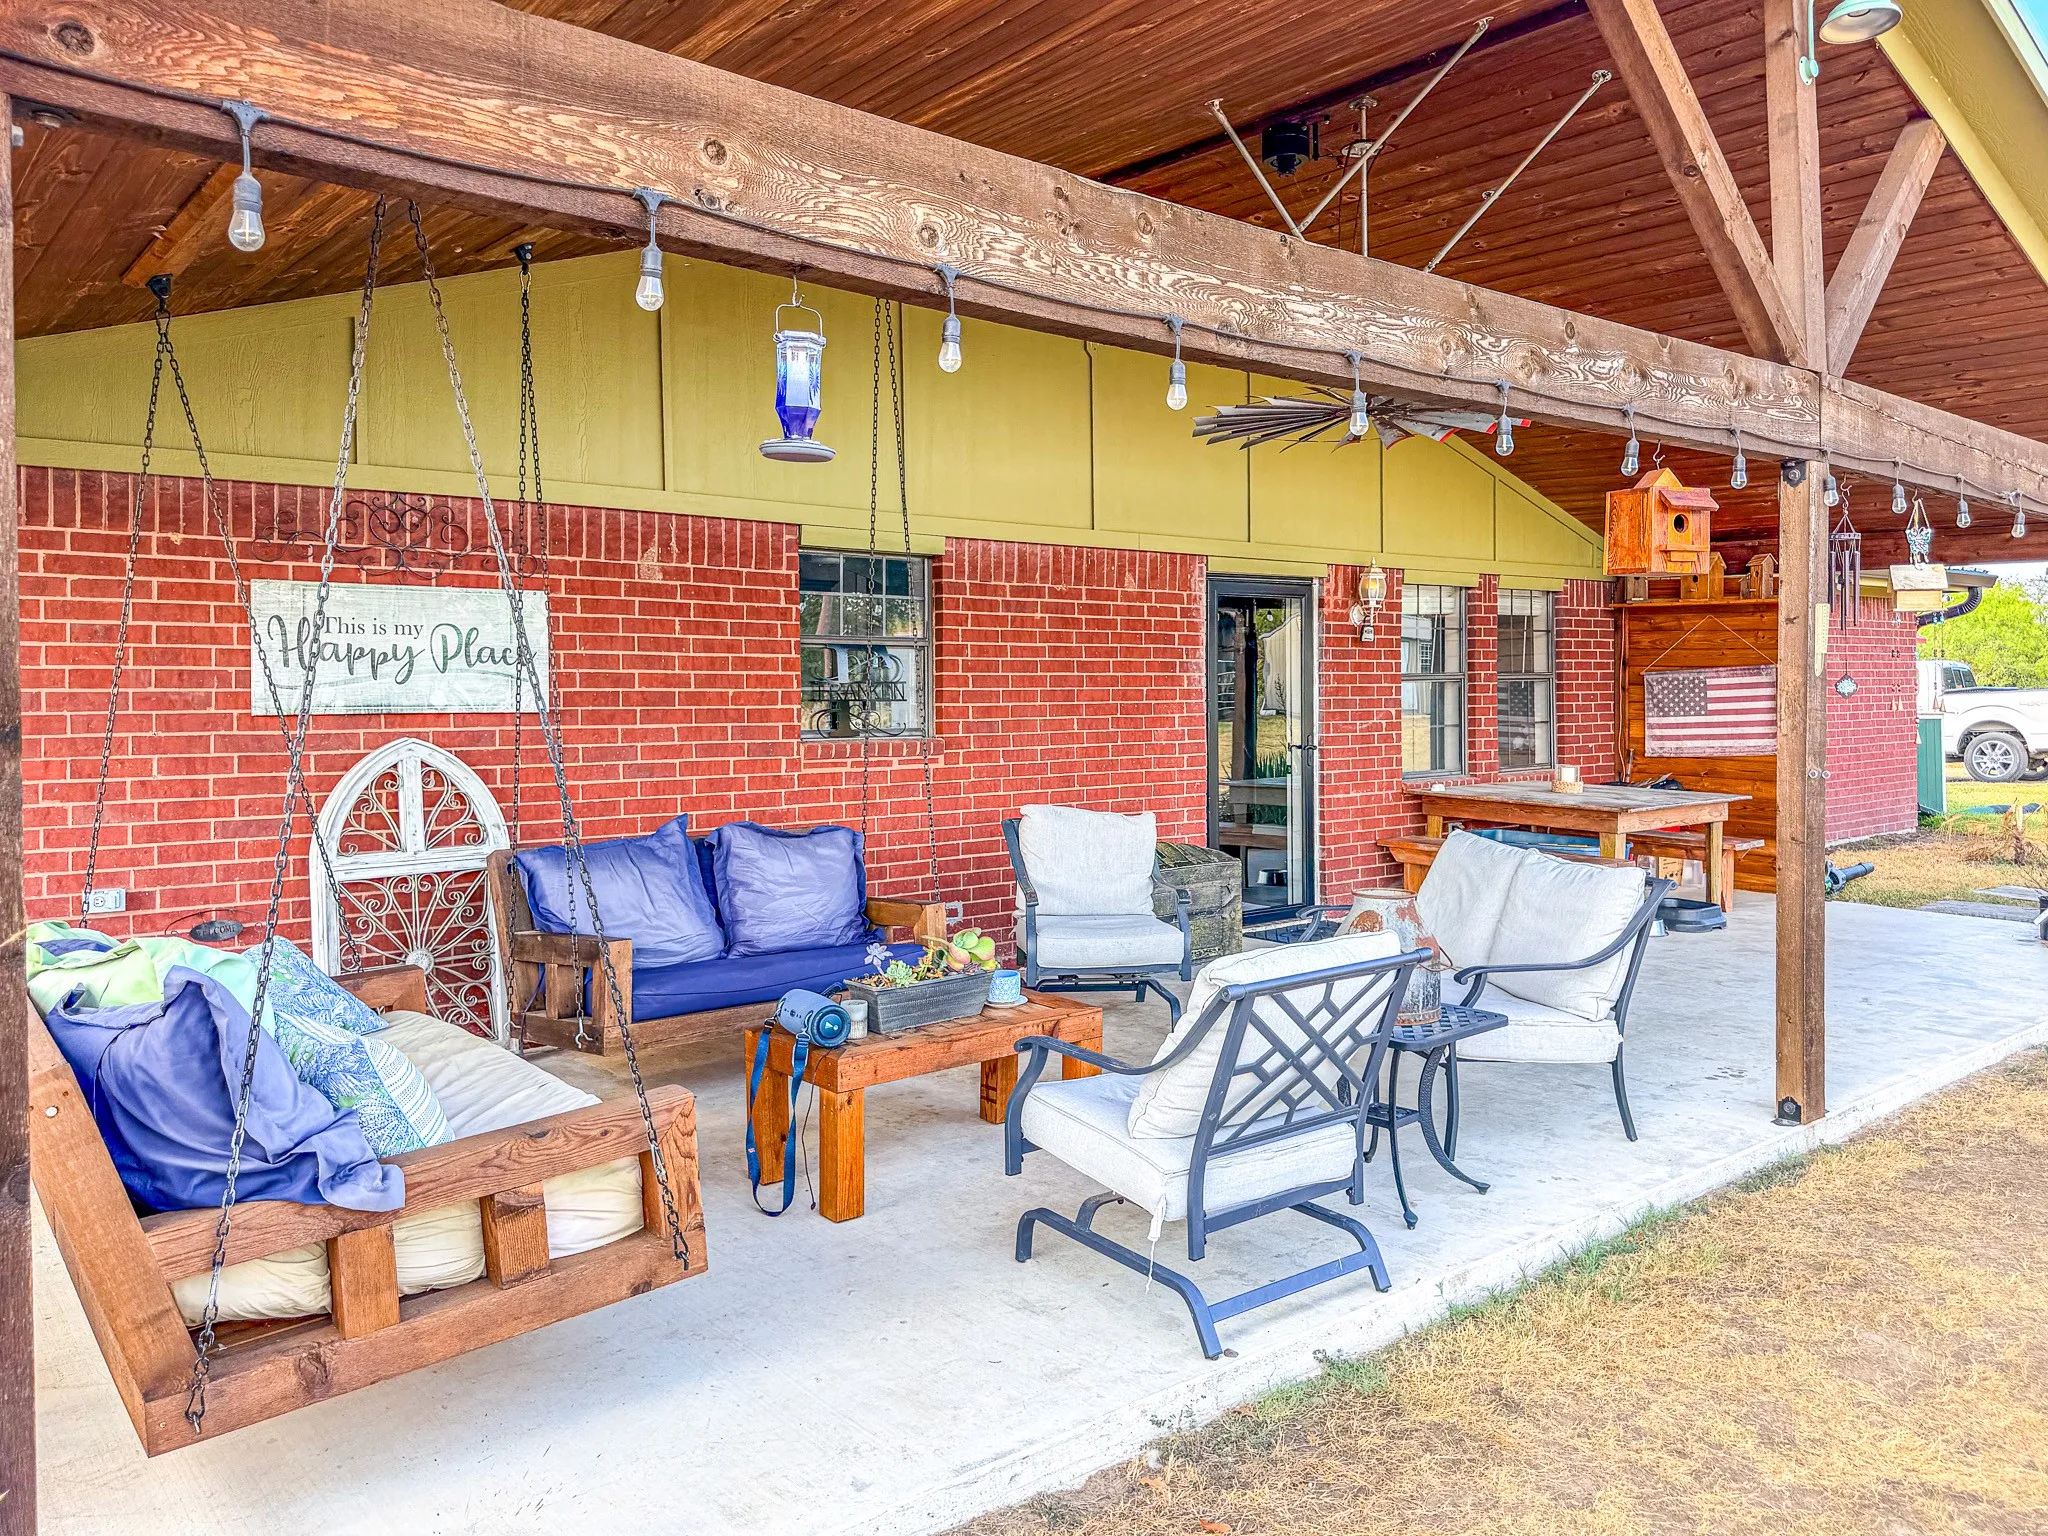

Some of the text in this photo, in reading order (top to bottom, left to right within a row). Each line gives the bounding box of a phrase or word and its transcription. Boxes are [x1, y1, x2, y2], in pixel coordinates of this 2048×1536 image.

[267, 614, 538, 685] Happy Plac
[322, 617, 424, 640] This is my
